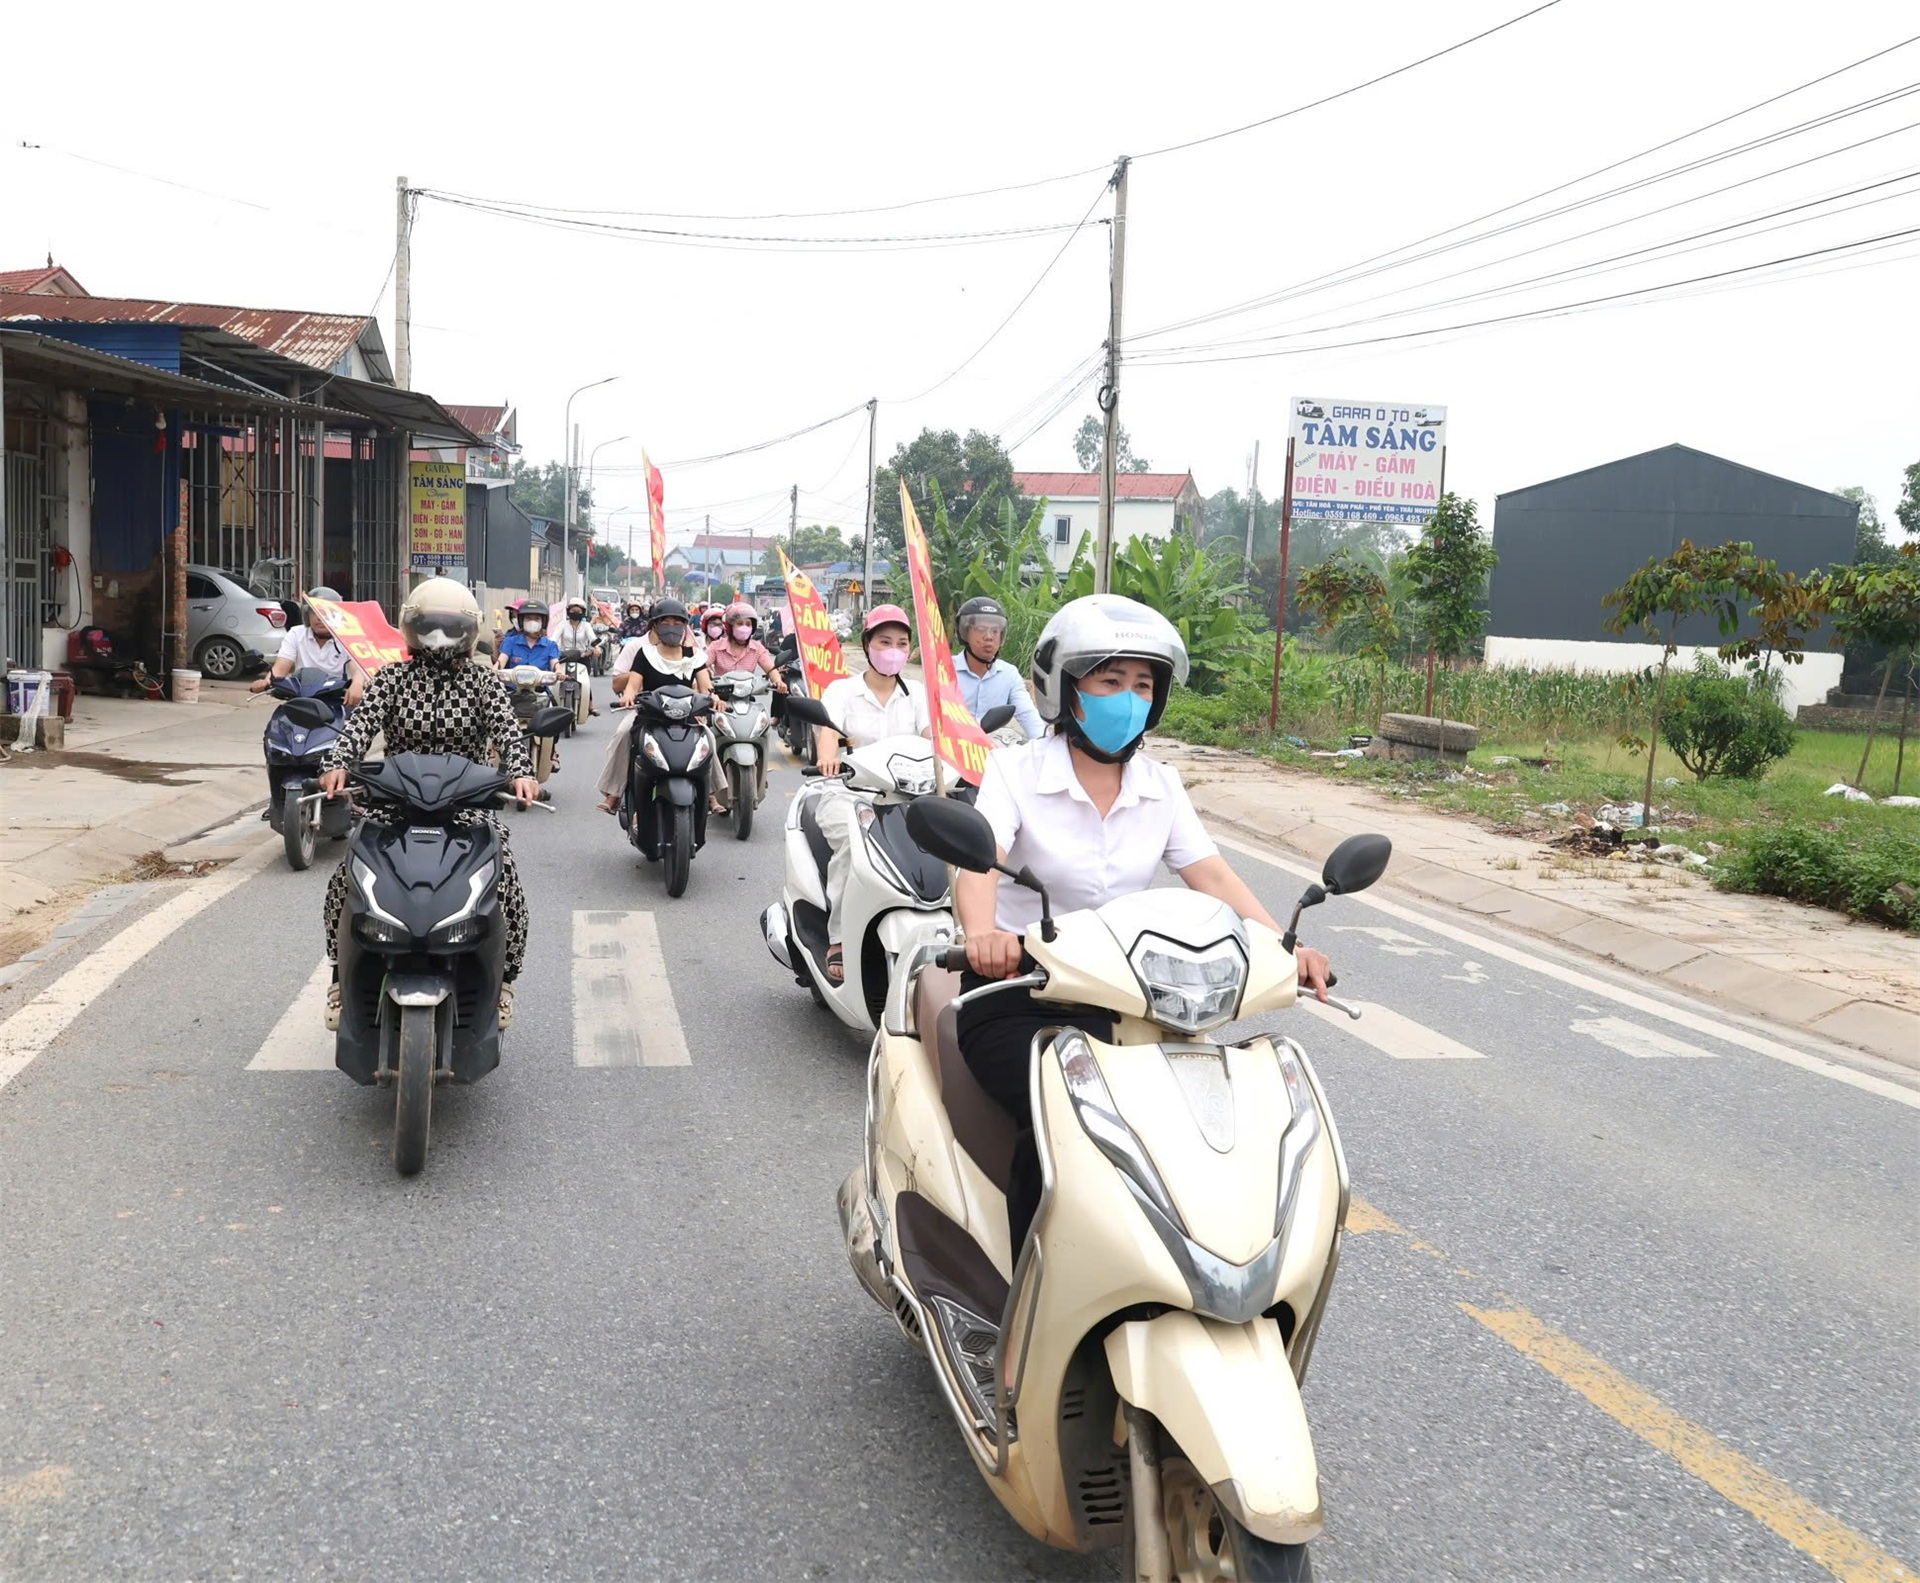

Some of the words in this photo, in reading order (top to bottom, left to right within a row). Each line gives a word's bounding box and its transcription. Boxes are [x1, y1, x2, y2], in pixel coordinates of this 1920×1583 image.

[1332, 406, 1371, 420] GARA
[1302, 417, 1358, 448] TÂM
[1365, 421, 1437, 452] SÁNG
[1318, 451, 1358, 471] MÁY
[1375, 452, 1416, 475] GẦM
[412, 474, 434, 488] TÂM
[436, 475, 464, 489] SÁNG
[1295, 474, 1337, 498] ĐIỆN
[1354, 475, 1395, 498] ĐIỀU
[1400, 480, 1436, 500] HOÀ
[793, 602, 834, 632] CẤM
